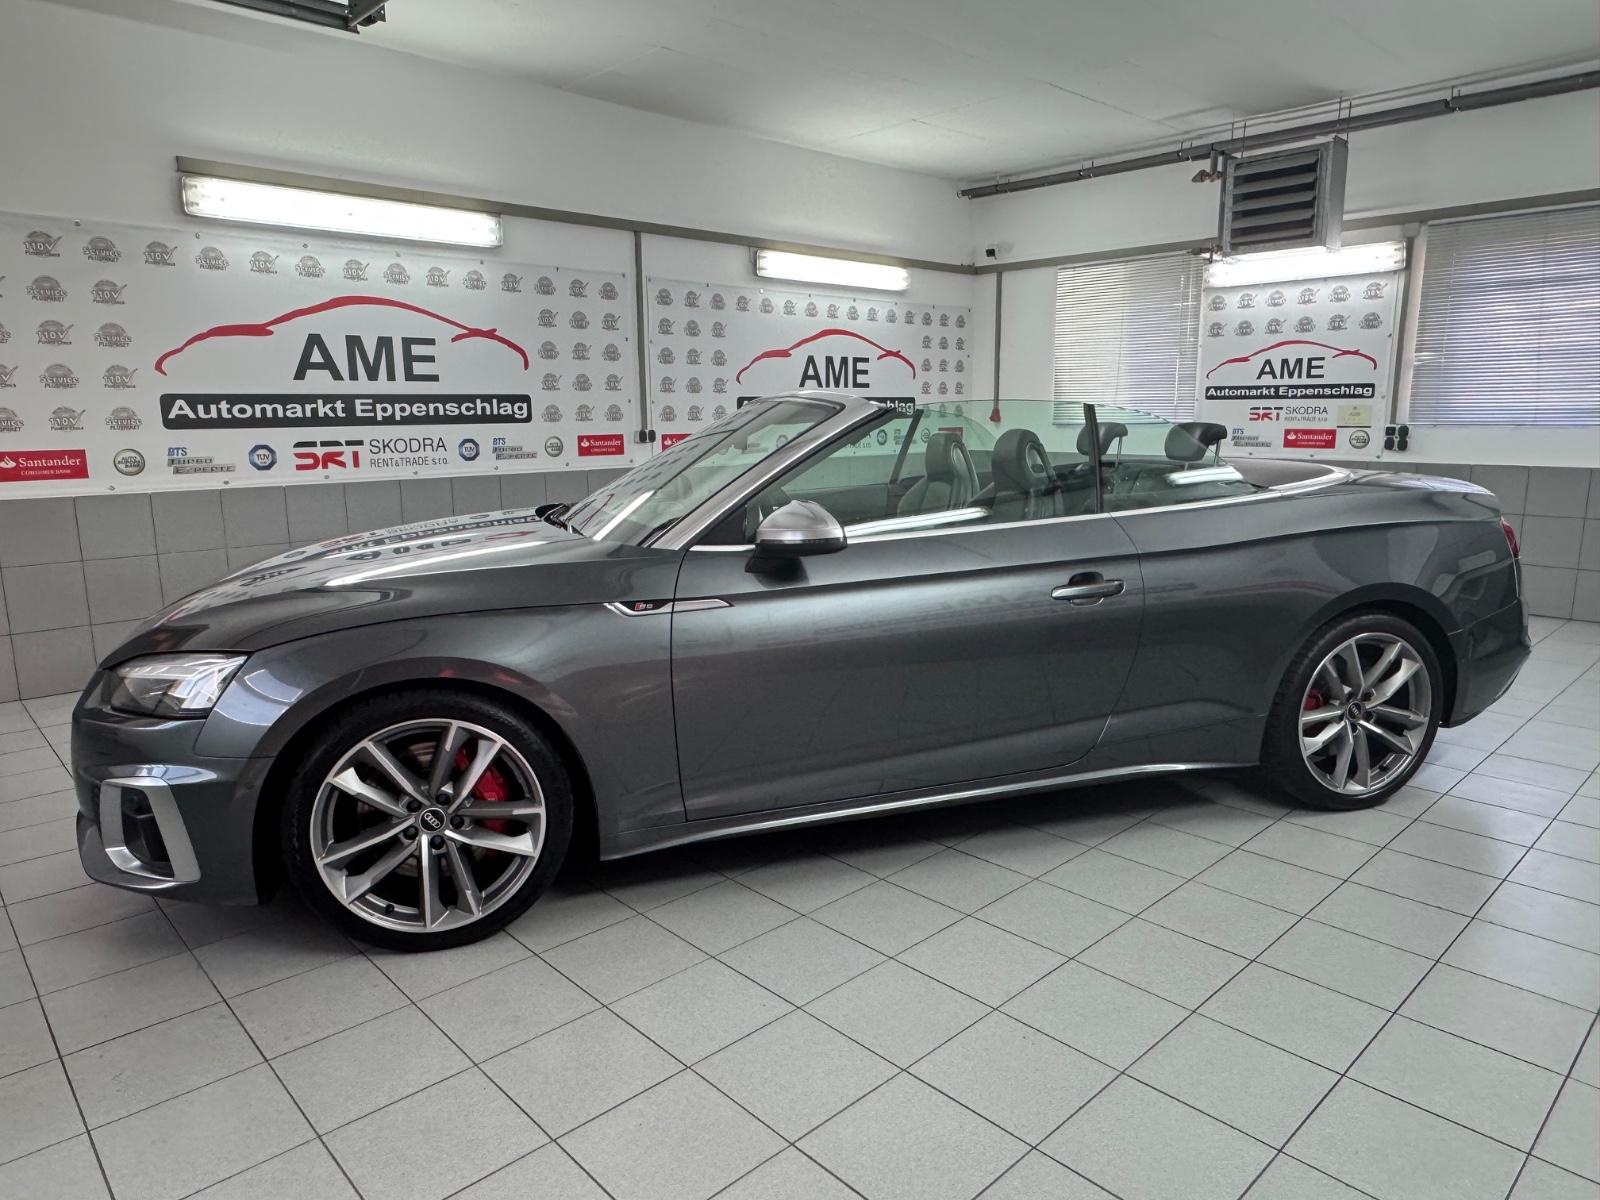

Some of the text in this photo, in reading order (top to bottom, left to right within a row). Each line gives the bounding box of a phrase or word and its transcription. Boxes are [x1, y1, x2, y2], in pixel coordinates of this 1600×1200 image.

[293, 333, 440, 382] AME
[798, 355, 870, 388] AME
[1256, 357, 1326, 380] AME
[1207, 386, 1373, 397] Automarkt Eppenschlag
[168, 399, 346, 419] Automarkt
[355, 398, 528, 421] Eppenschlag
[1249, 406, 1284, 422] SRT
[1285, 406, 1328, 415] SKODRA
[590, 438, 621, 447] Santander
[1297, 432, 1333, 441] Santander
[167, 447, 187, 456] BTS
[369, 437, 448, 454] SKODRA
[19, 455, 81, 467] Santander
[293, 439, 365, 471] SRT
[370, 457, 429, 468] RENT&TRADE
